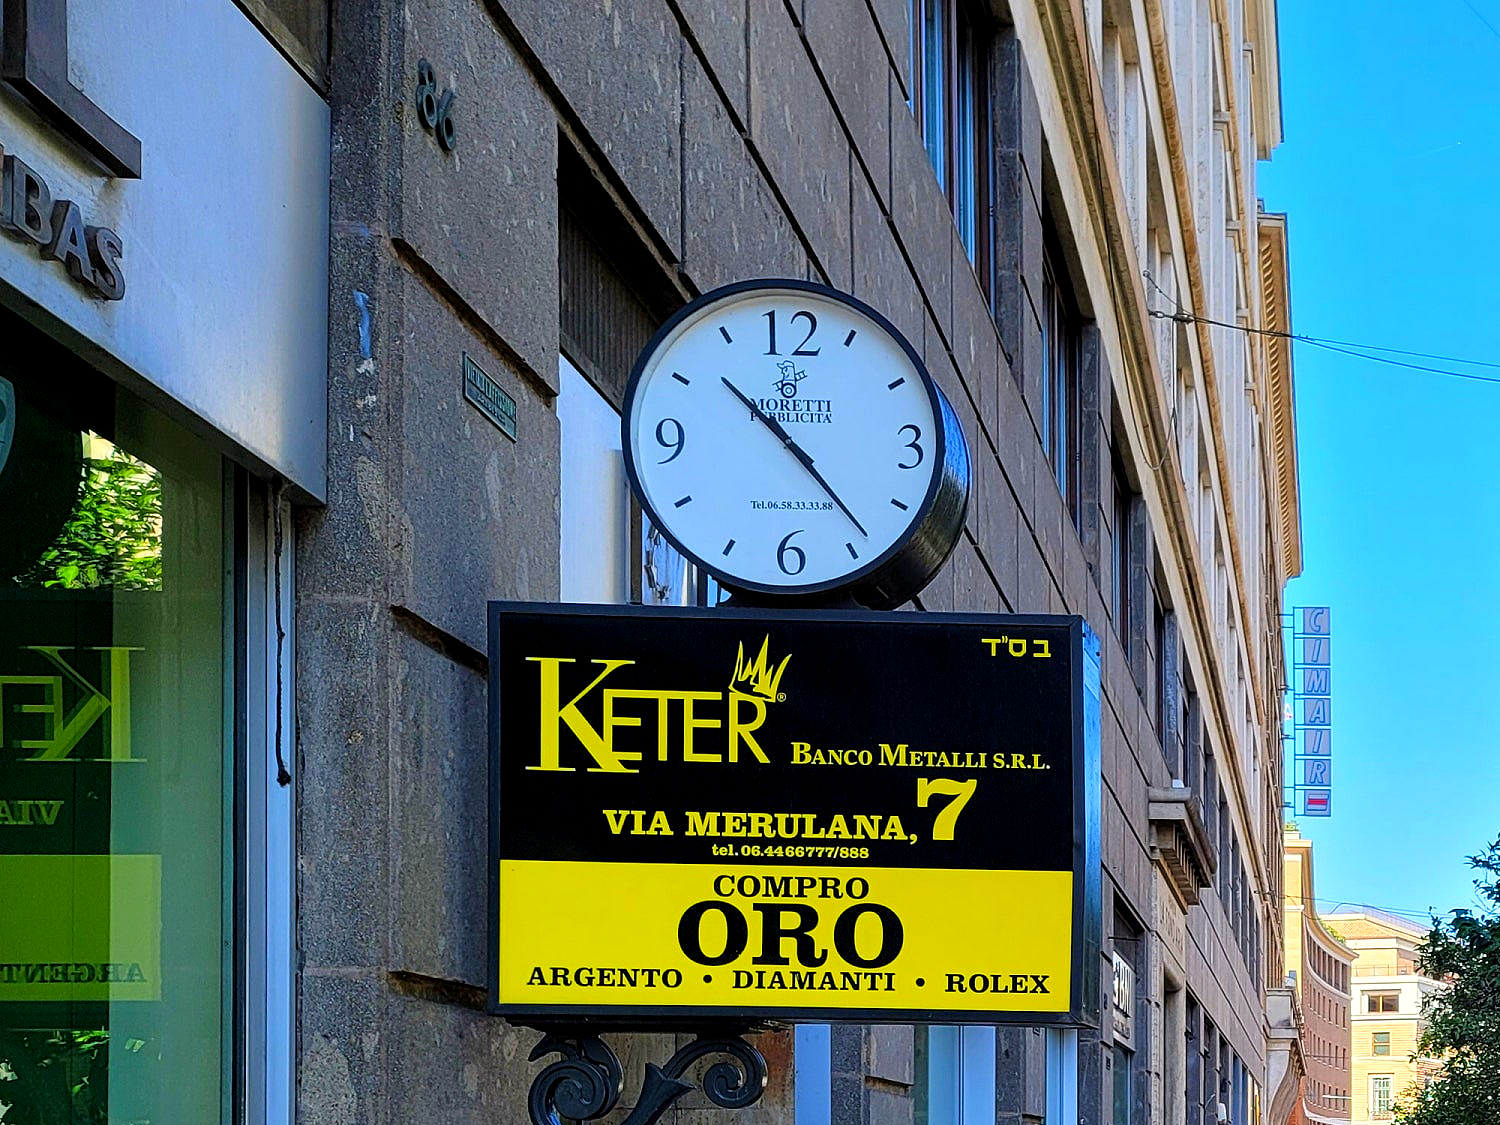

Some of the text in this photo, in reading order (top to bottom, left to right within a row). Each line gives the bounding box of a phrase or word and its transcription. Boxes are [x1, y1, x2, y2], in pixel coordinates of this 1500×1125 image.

[416, 58, 457, 151] 86
[0, 146, 125, 300] BAS
[762, 309, 821, 357] 12
[751, 398, 832, 412] MORETTI
[655, 418, 685, 465] 9
[897, 424, 924, 470] 3
[750, 500, 834, 511] Tel.06.58.33.33.88
[776, 529, 806, 576] 6
[525, 656, 770, 774] KETER
[1306, 608, 1328, 785] CIMAIR
[994, 748, 1051, 770] S.R.L.
[603, 777, 978, 845] VIA MERULANA, 7
[711, 844, 870, 860] tel. 06.4466777/888
[713, 874, 870, 900] COMPRO
[677, 900, 904, 969] ORO
[526, 967, 1050, 994] ARGENTO DIAMANTI ROLEX
